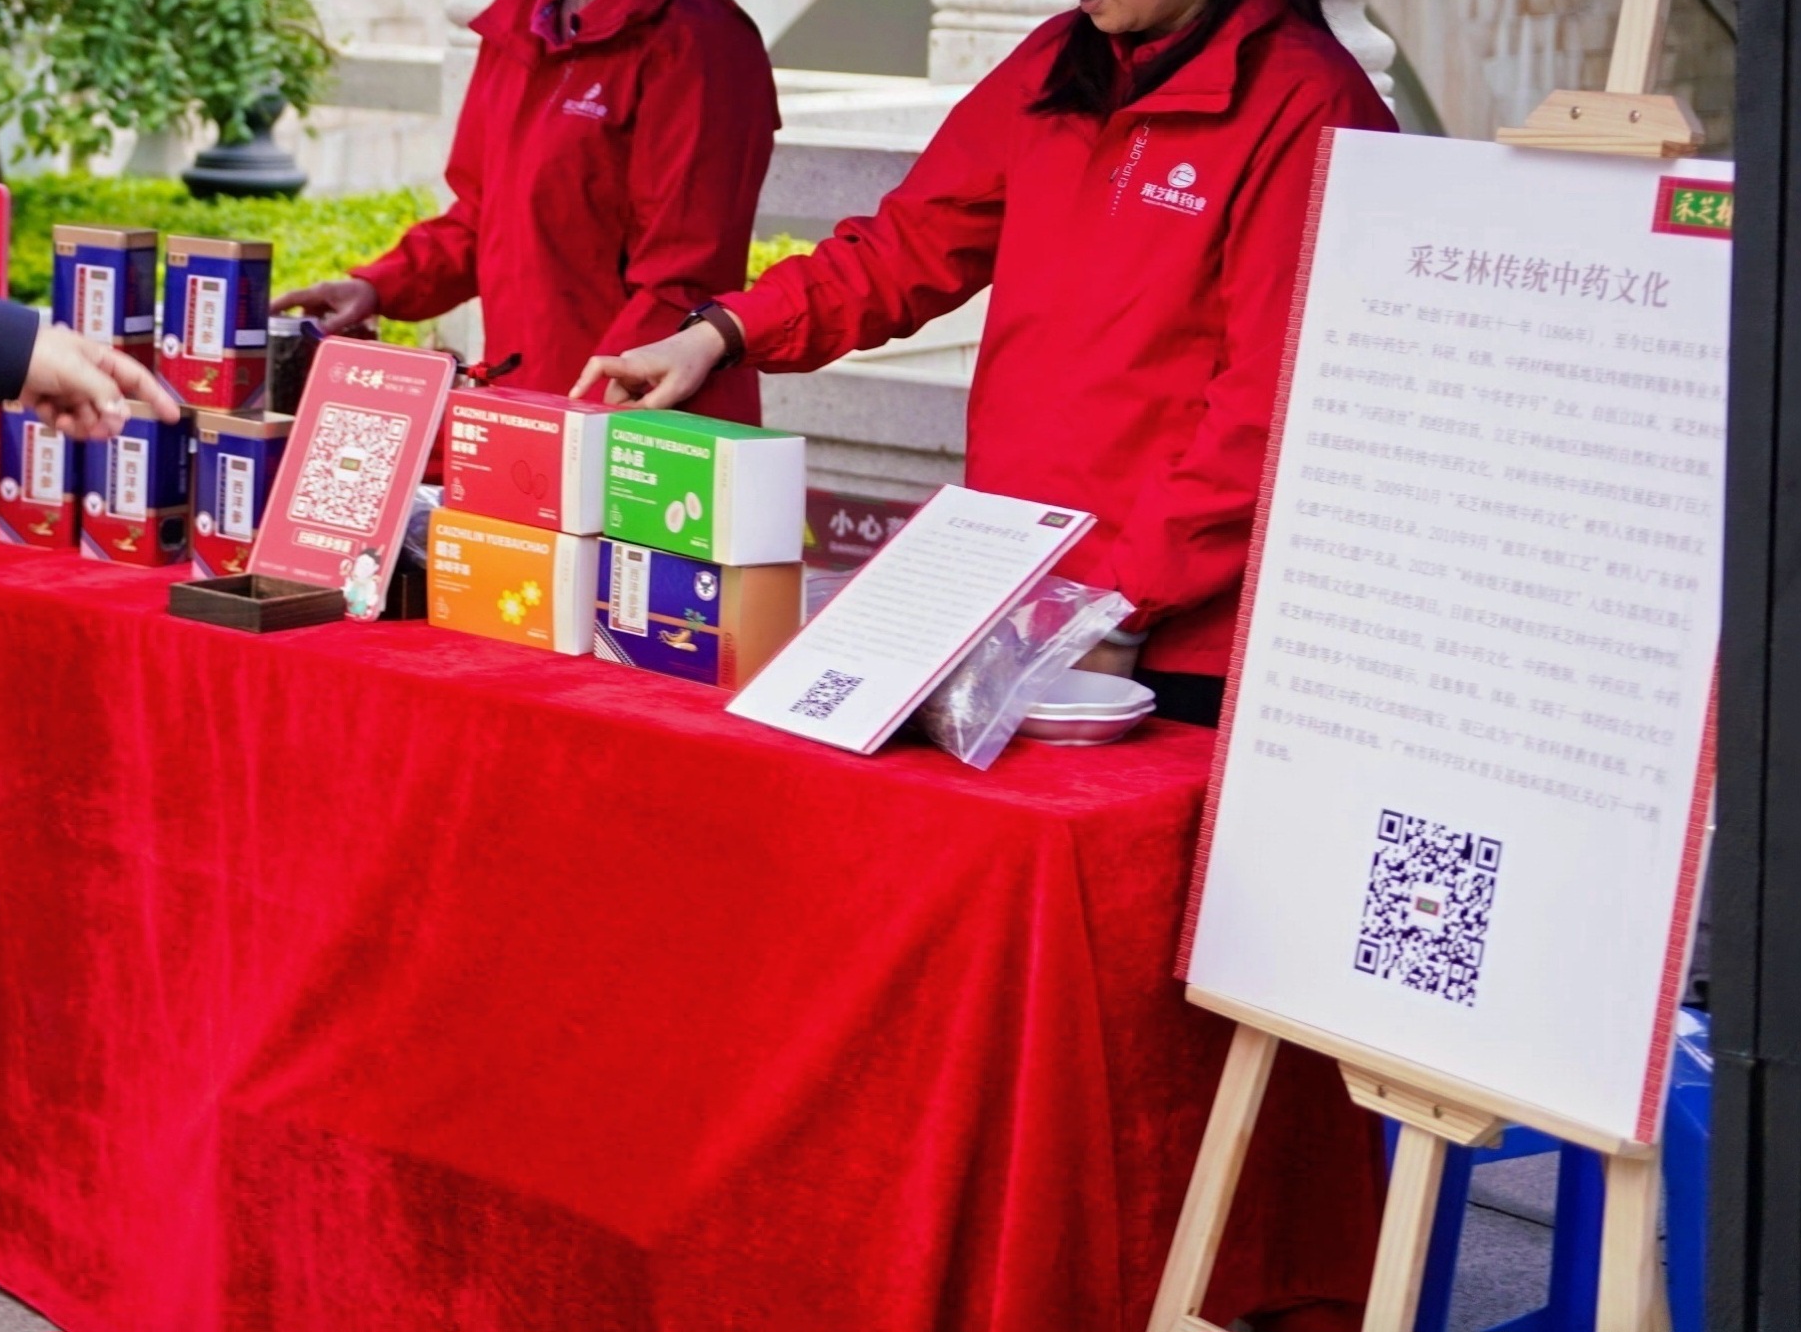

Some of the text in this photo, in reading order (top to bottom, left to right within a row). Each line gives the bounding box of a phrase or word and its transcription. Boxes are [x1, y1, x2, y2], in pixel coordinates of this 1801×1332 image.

[1406, 244, 1670, 309] 采芝林传统中药文化
